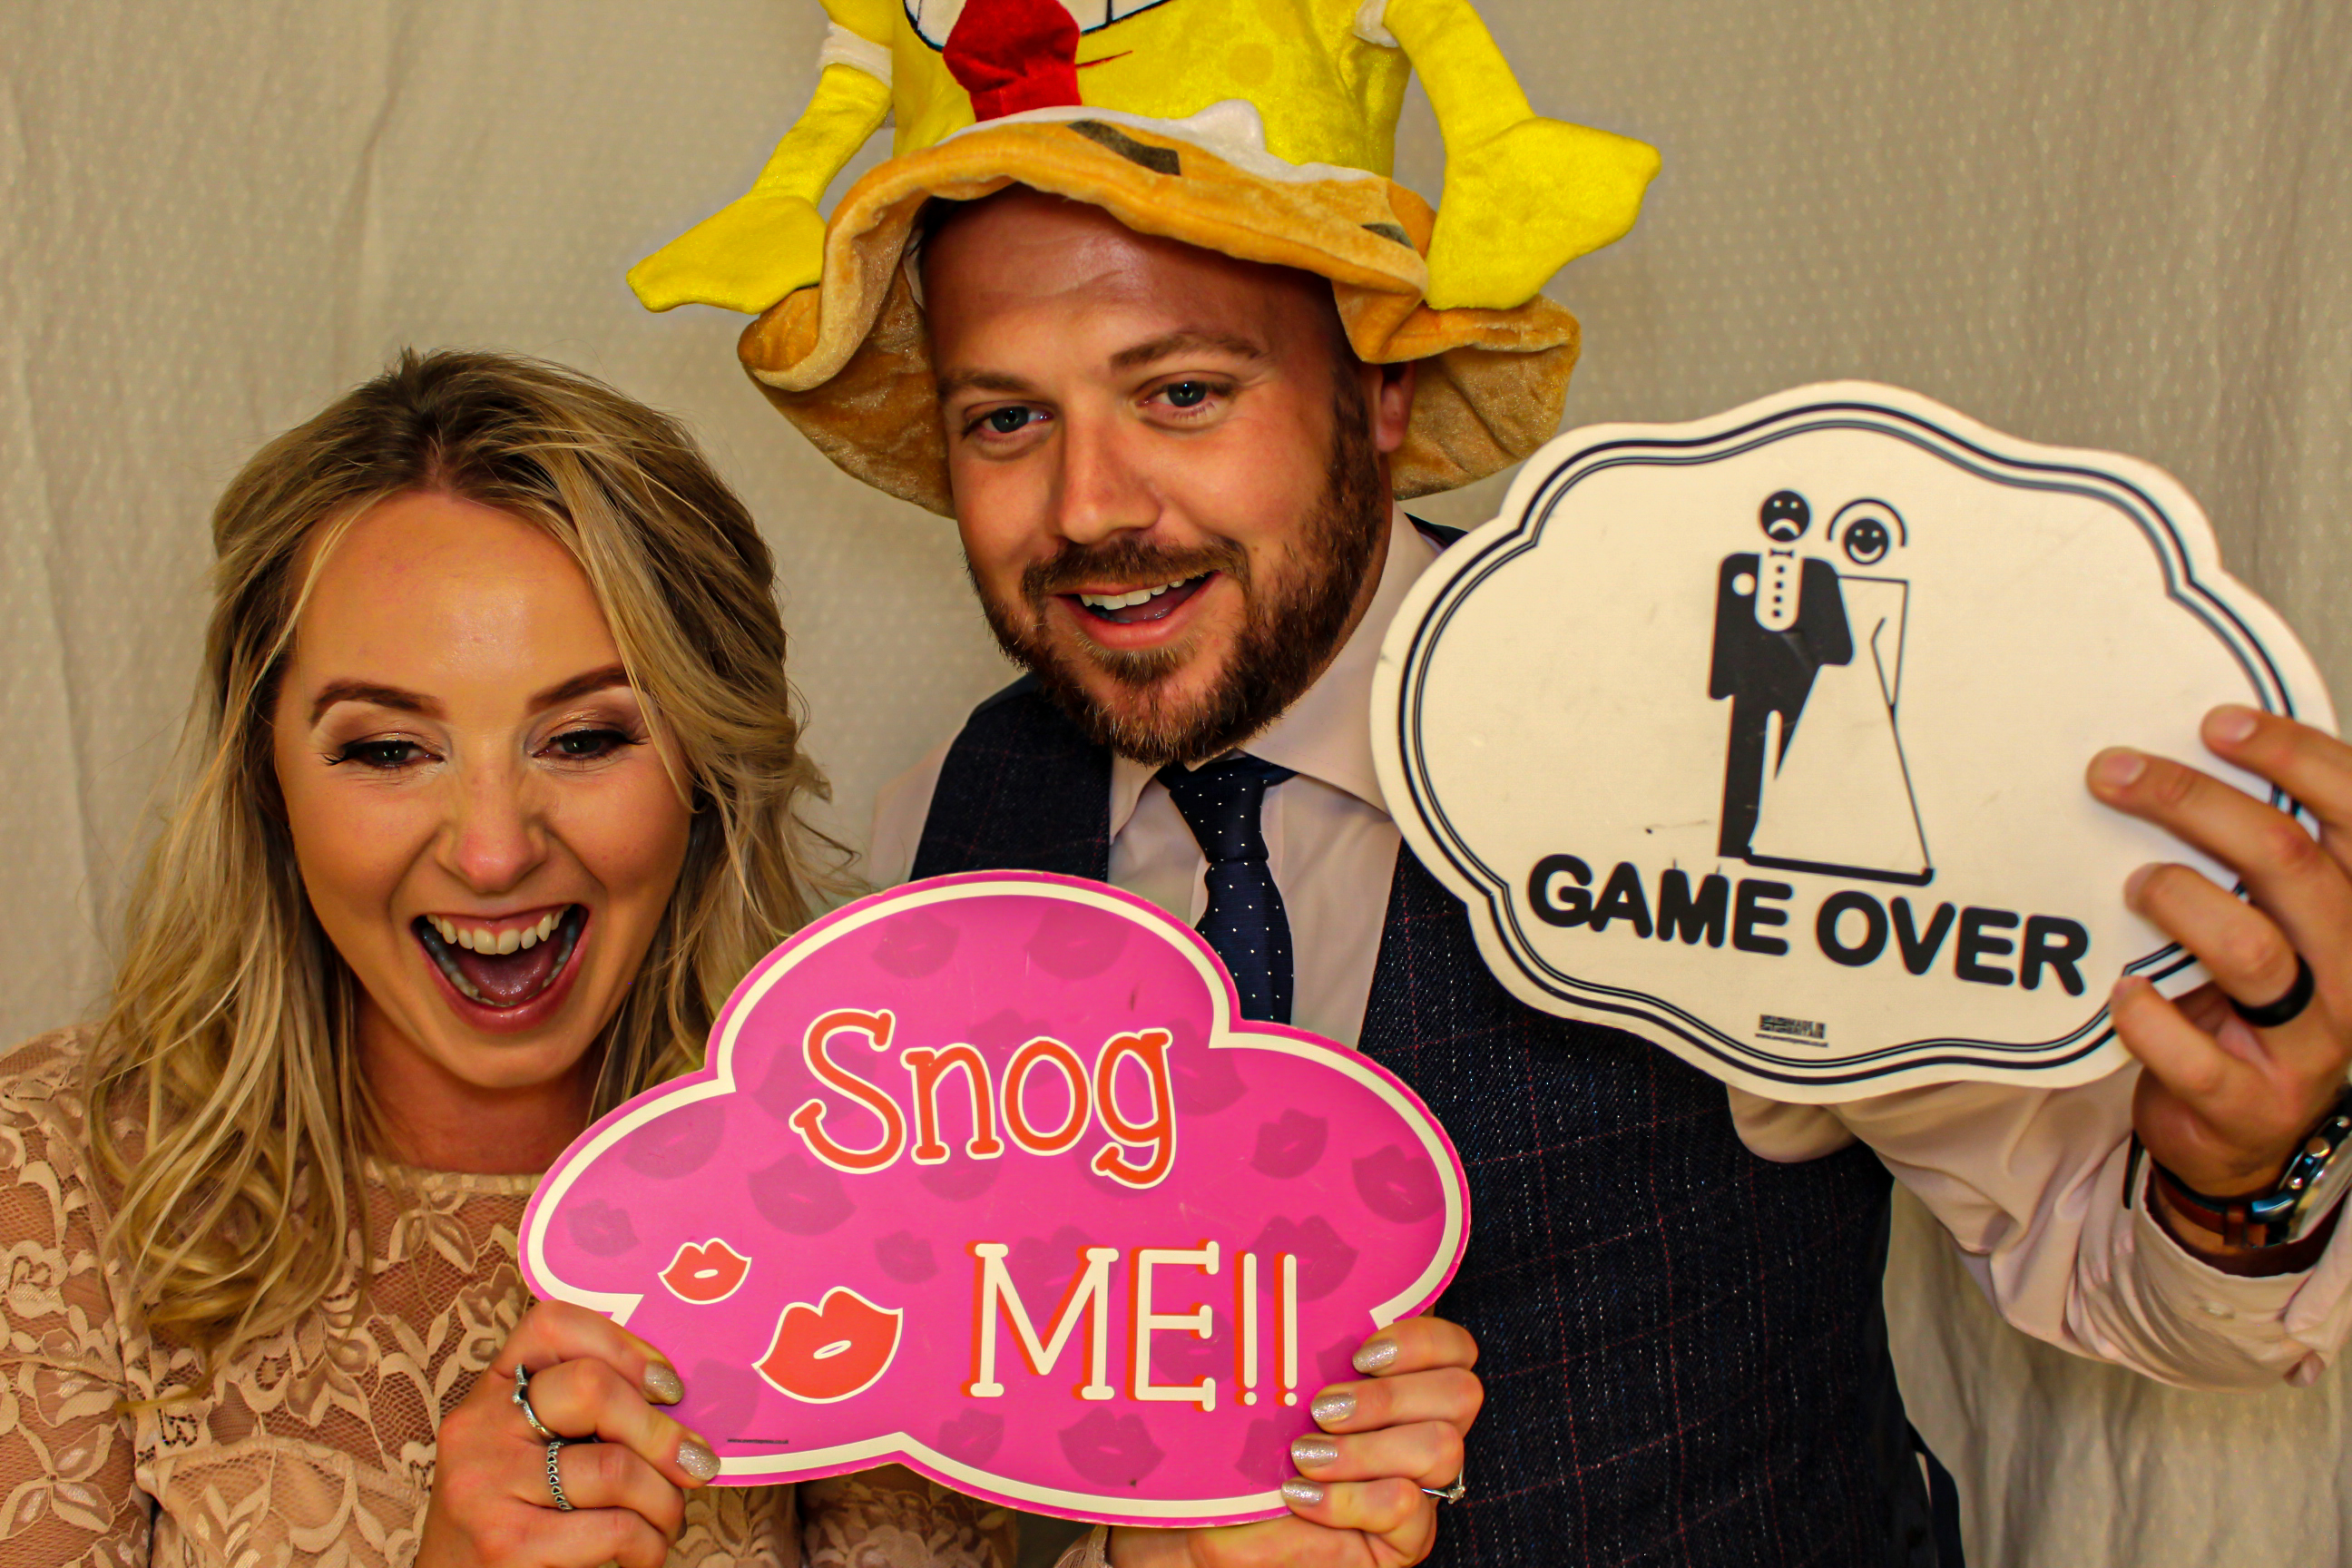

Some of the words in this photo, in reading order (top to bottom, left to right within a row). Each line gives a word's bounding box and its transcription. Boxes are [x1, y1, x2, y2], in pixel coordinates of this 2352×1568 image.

[1526, 853, 1794, 957] GAME
[1816, 889, 2090, 996] OVER
[789, 1007, 1177, 1190] Snog
[961, 1238, 1298, 1412] ME!!
